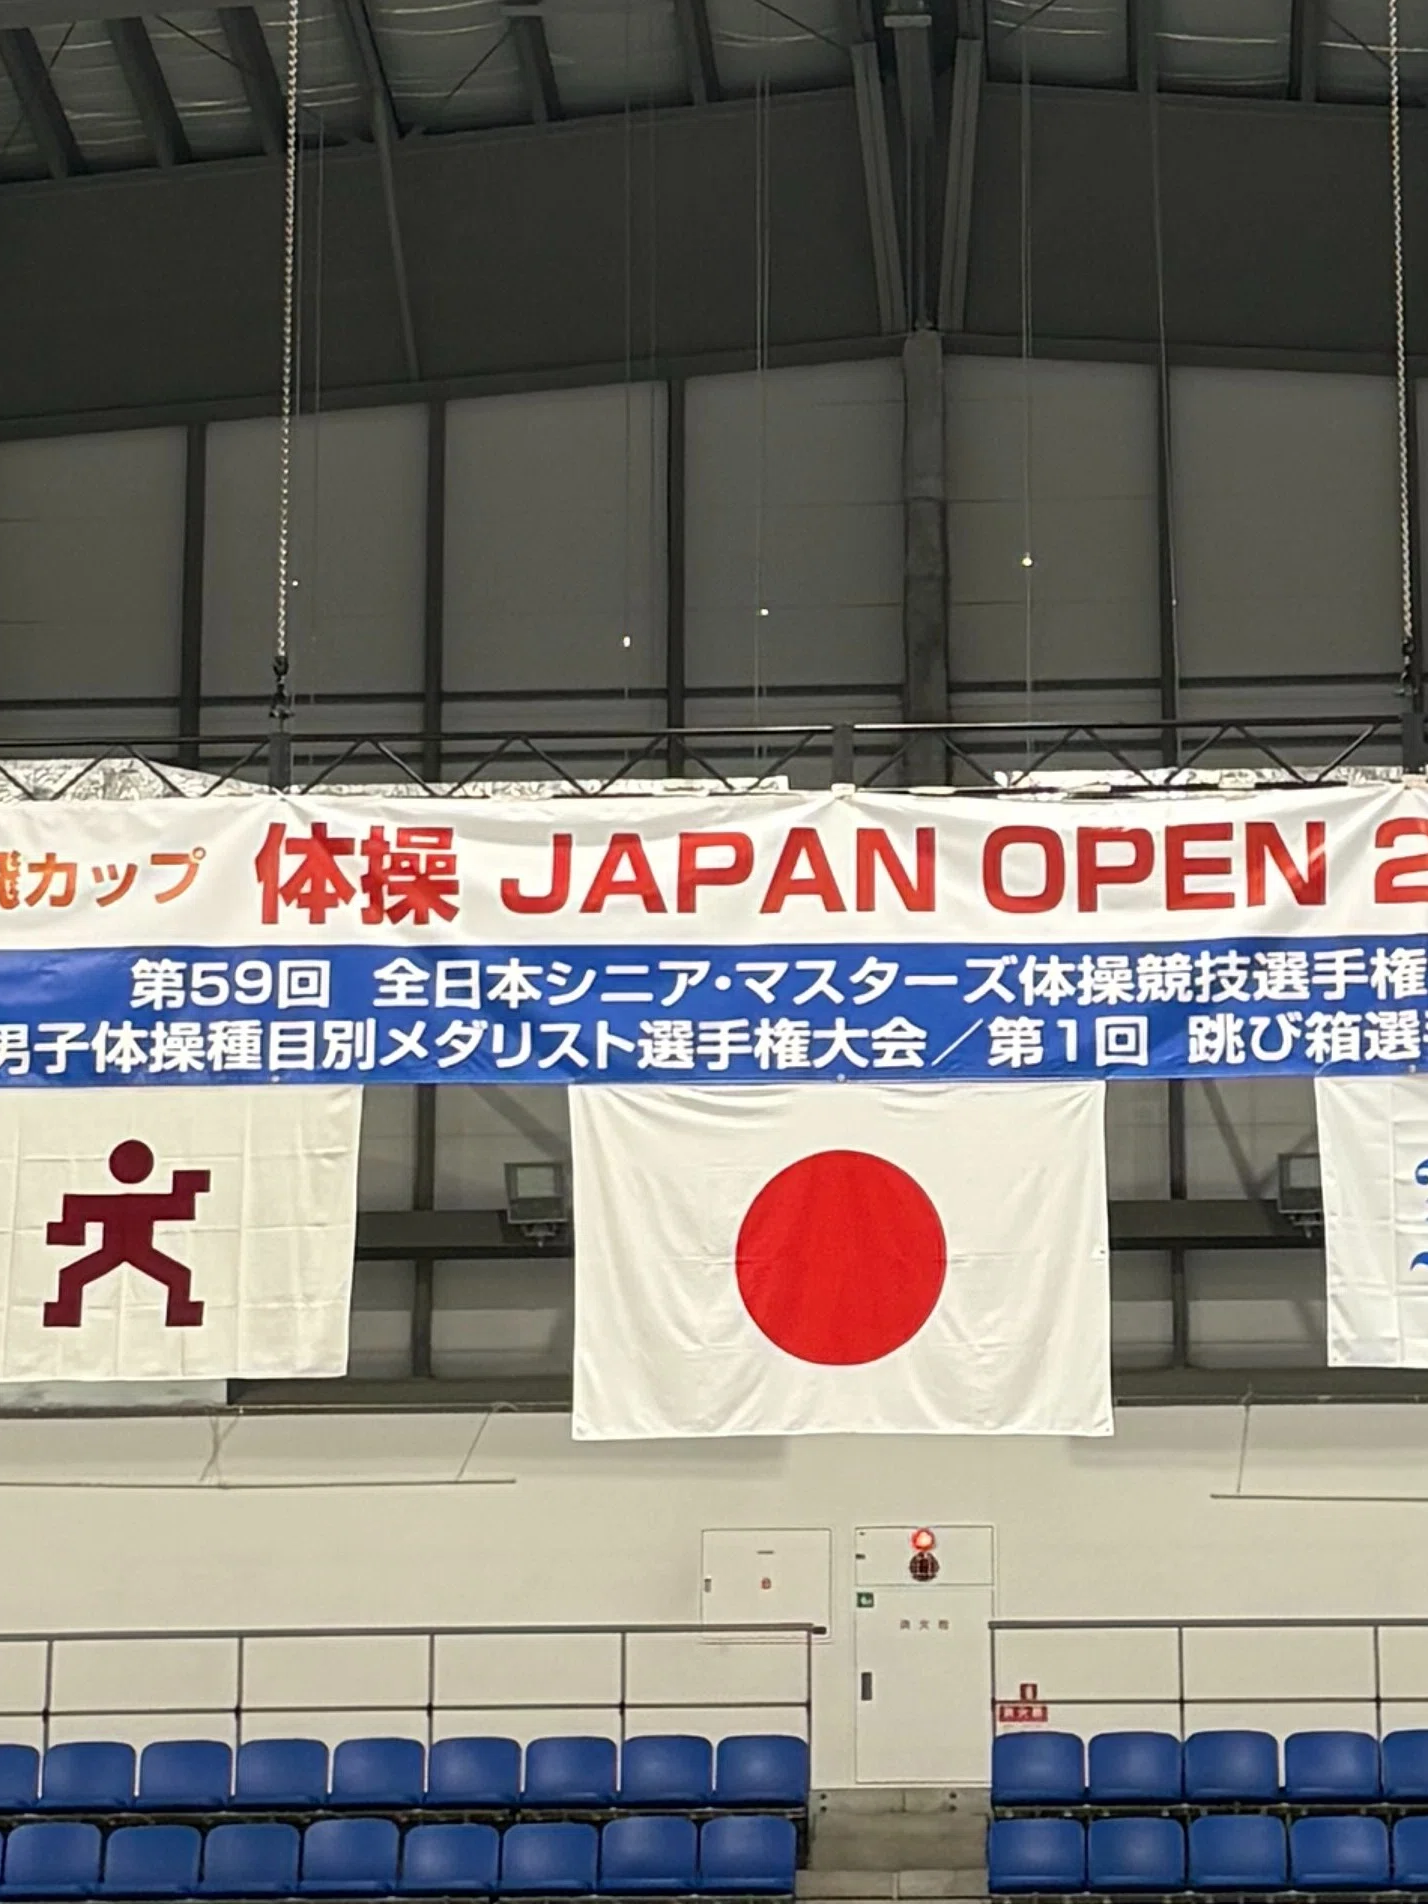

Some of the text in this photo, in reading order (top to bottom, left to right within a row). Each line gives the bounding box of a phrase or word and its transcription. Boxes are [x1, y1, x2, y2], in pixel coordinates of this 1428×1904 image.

[254, 822, 461, 926] 体操
[501, 827, 937, 915] JAPAN
[982, 822, 1327, 914] OPEN
[129, 957, 332, 1012] 第59回
